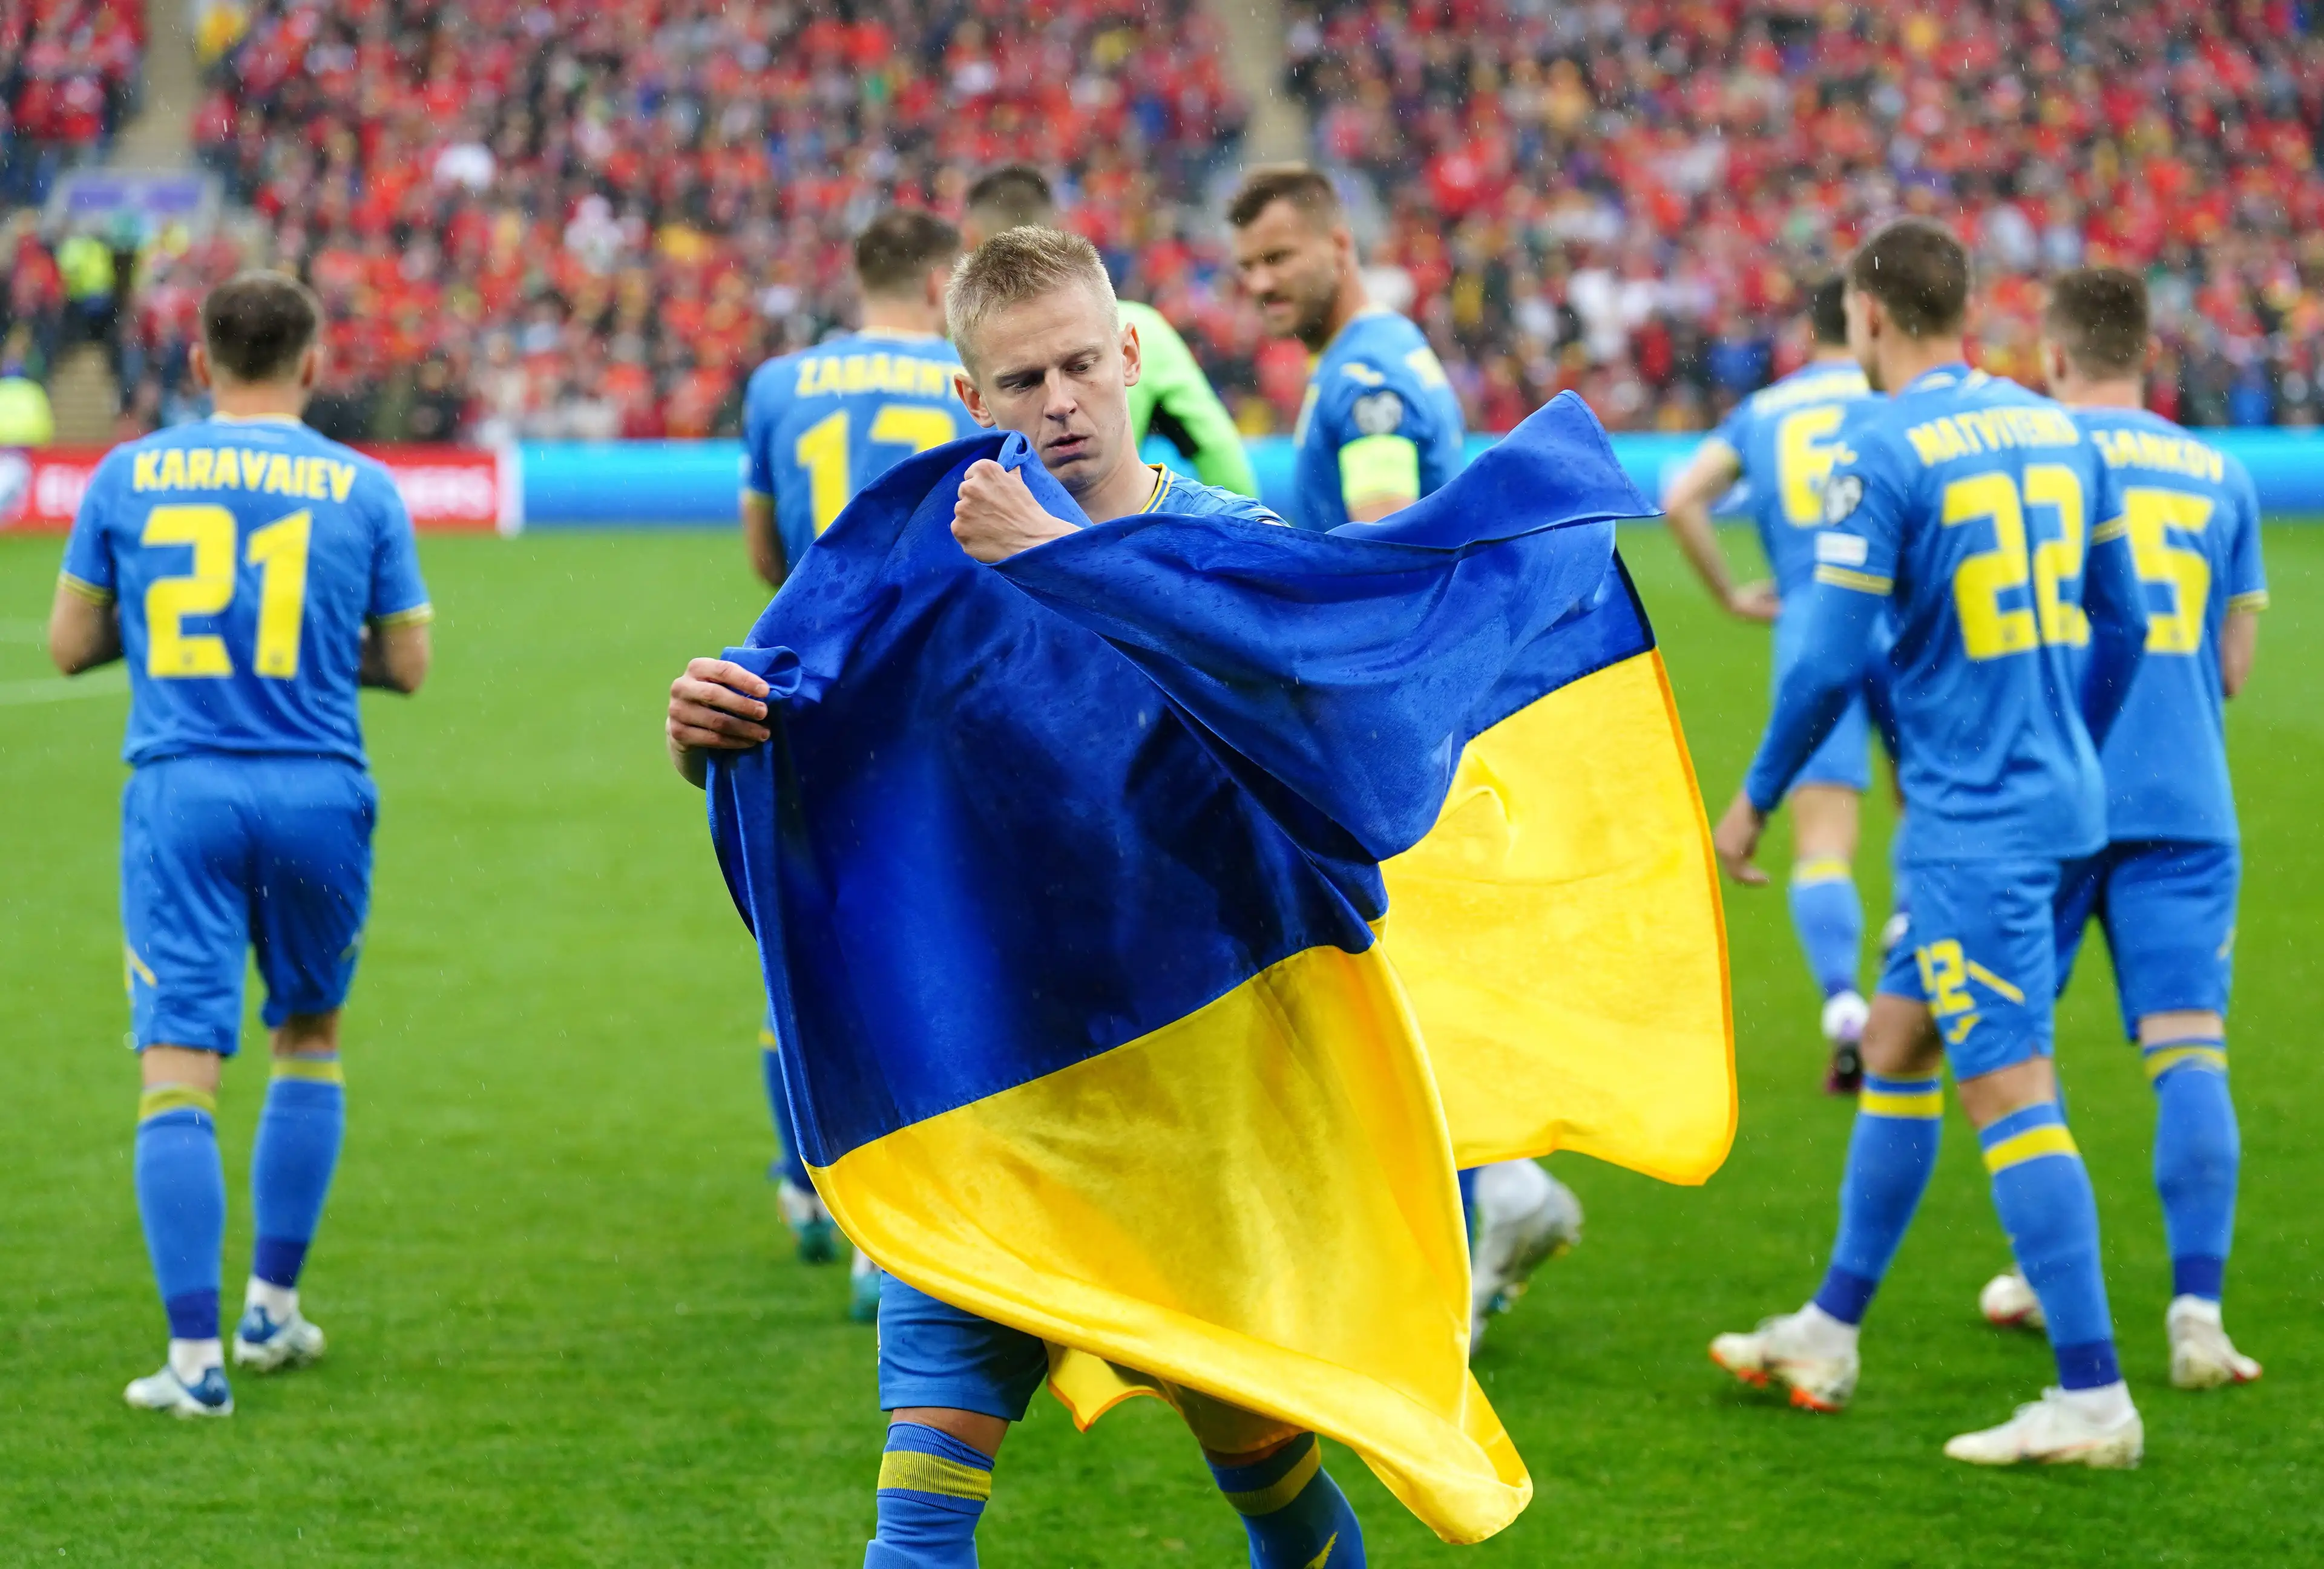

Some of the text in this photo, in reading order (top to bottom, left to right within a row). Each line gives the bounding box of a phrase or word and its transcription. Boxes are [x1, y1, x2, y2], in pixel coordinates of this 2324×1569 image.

[133, 448, 355, 502] KARAVAIEV
[1779, 406, 1841, 526] 6
[140, 504, 311, 679] 21
[1943, 465, 2090, 660] 22
[2125, 488, 2214, 654] 5
